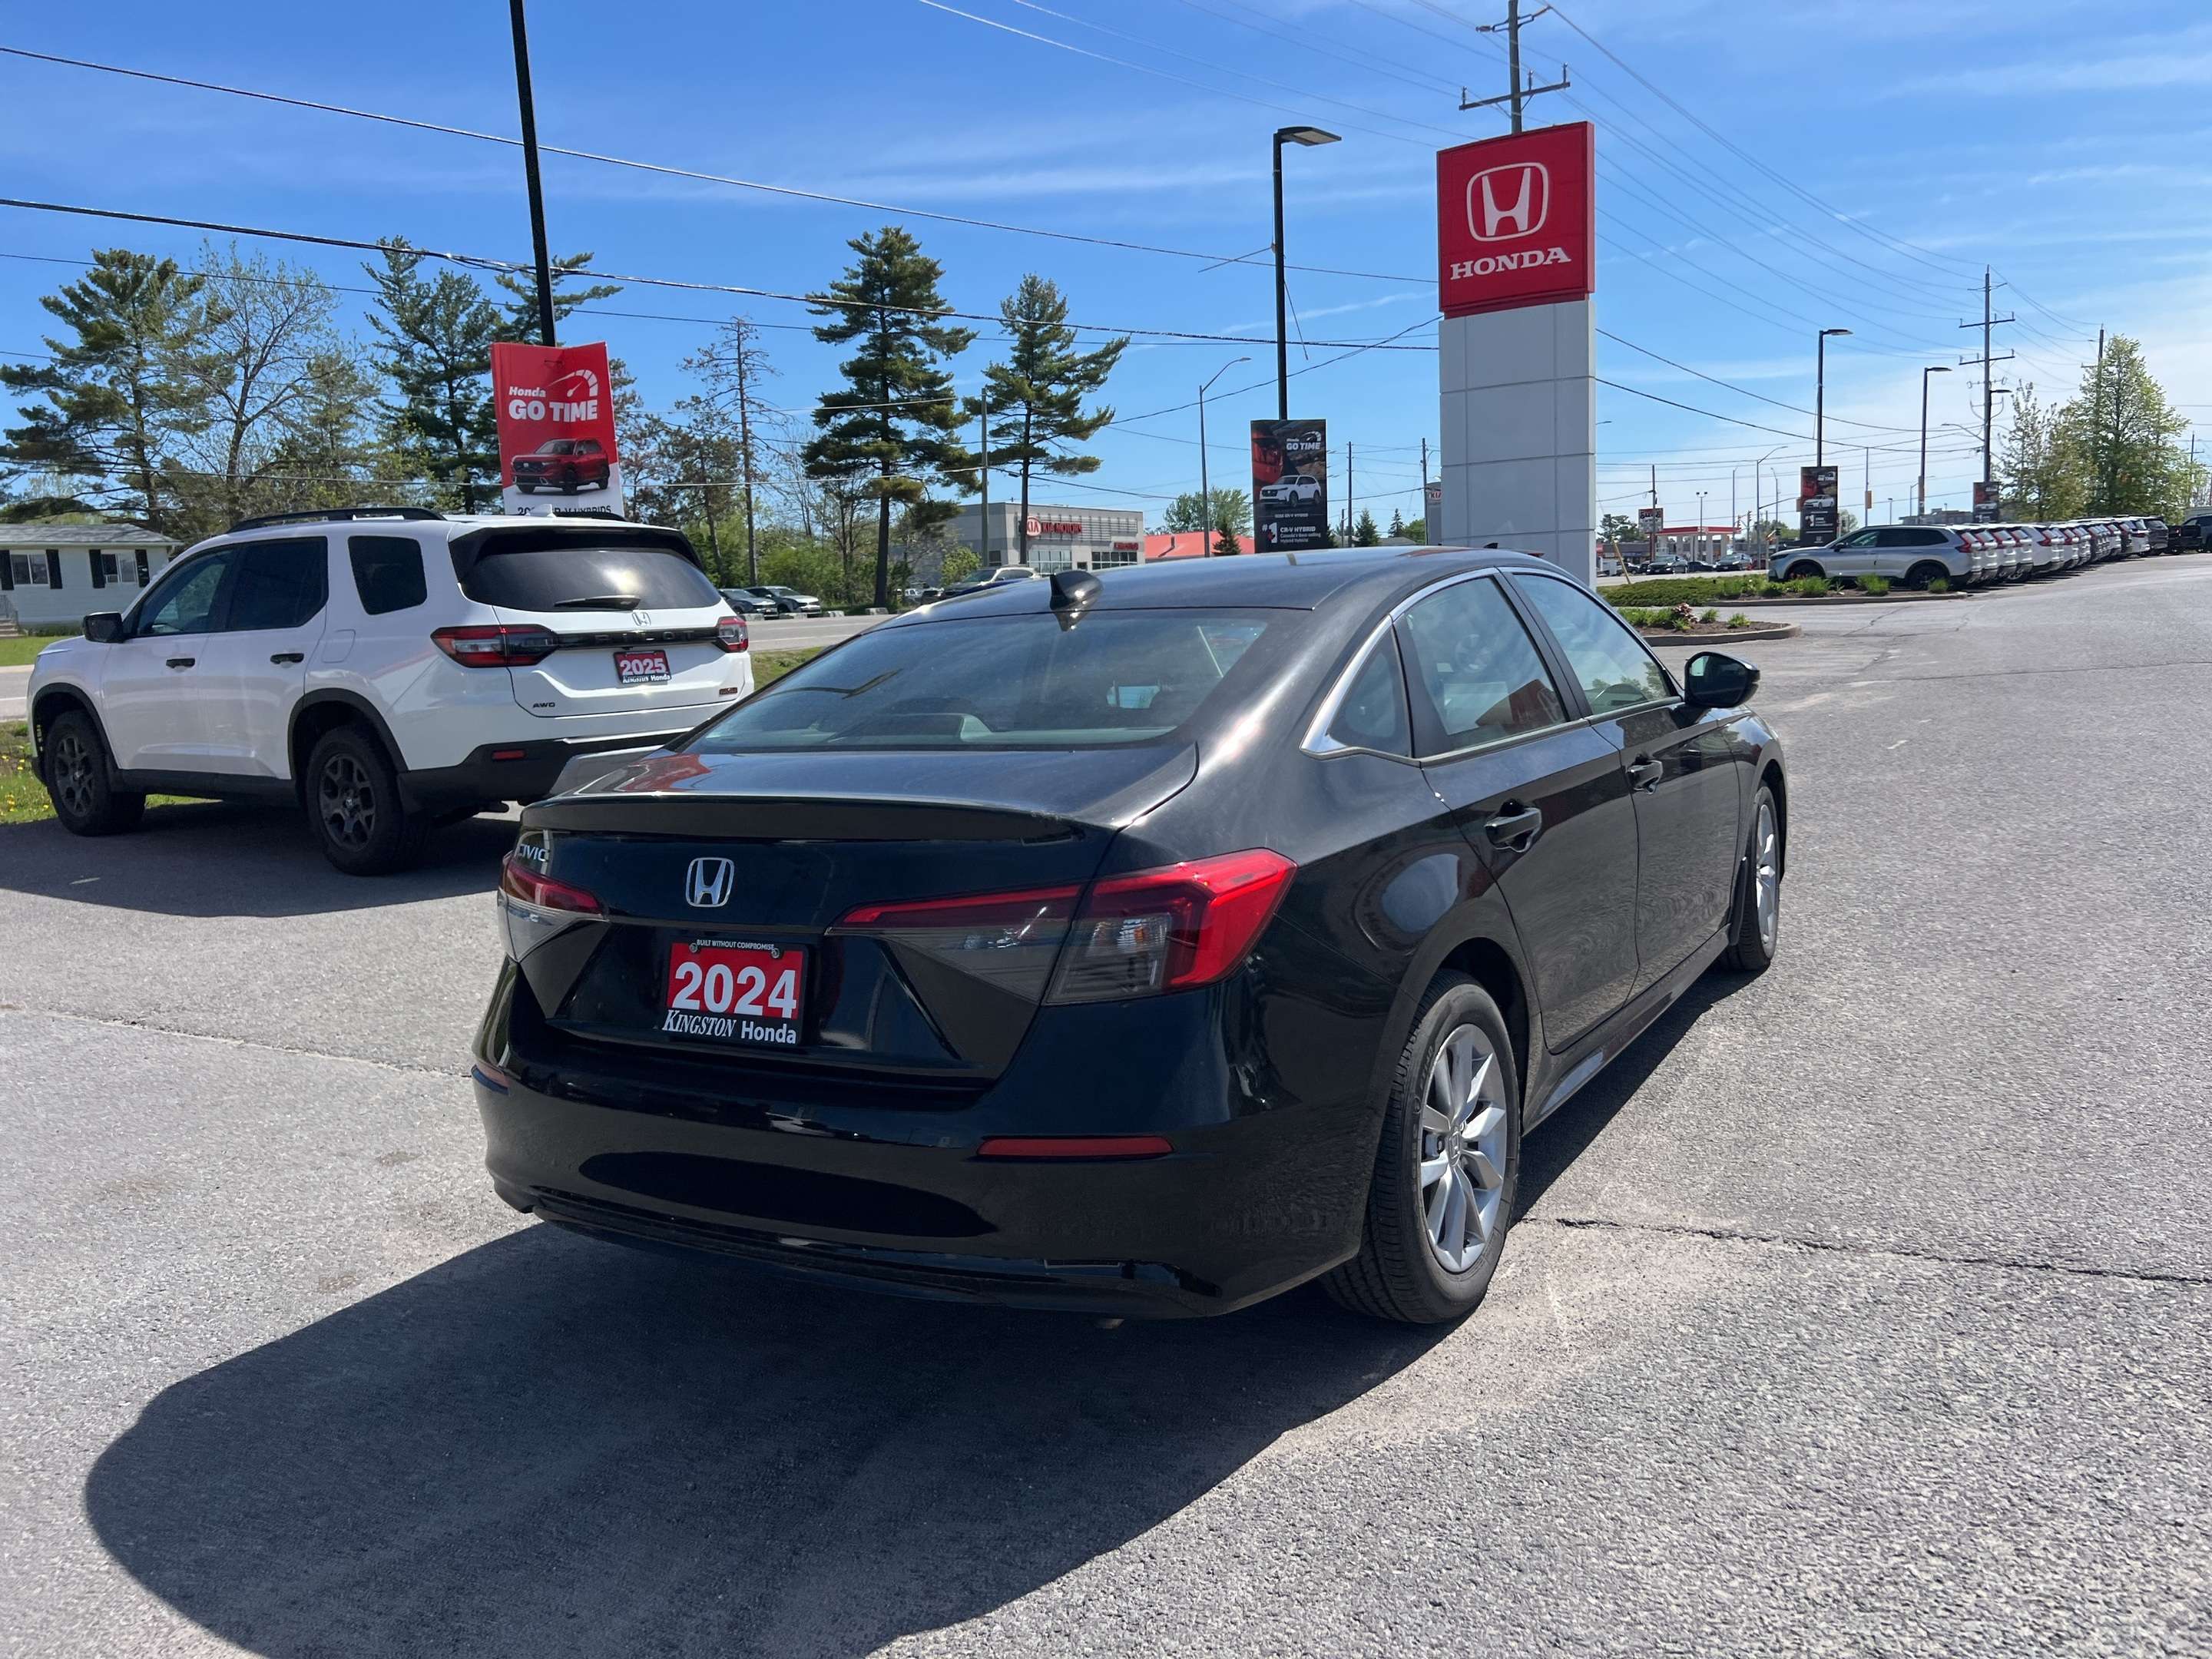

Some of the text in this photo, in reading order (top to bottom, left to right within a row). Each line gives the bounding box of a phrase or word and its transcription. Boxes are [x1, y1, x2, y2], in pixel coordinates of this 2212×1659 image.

[1450, 247, 1572, 280] HONDA
[508, 386, 546, 398] Honda
[508, 399, 598, 422] GO TIME
[1300, 442, 1321, 450] TIME
[1041, 522, 1082, 534] KIA MOTORS
[620, 658, 667, 676] 2025
[651, 674, 671, 682] Honda
[518, 843, 548, 863] CIVIC
[711, 939, 737, 949] WITHOUT
[737, 941, 775, 951] COMPROMISE
[672, 962, 797, 1020] 2024
[662, 1009, 797, 1045] KINGSTON Honda
